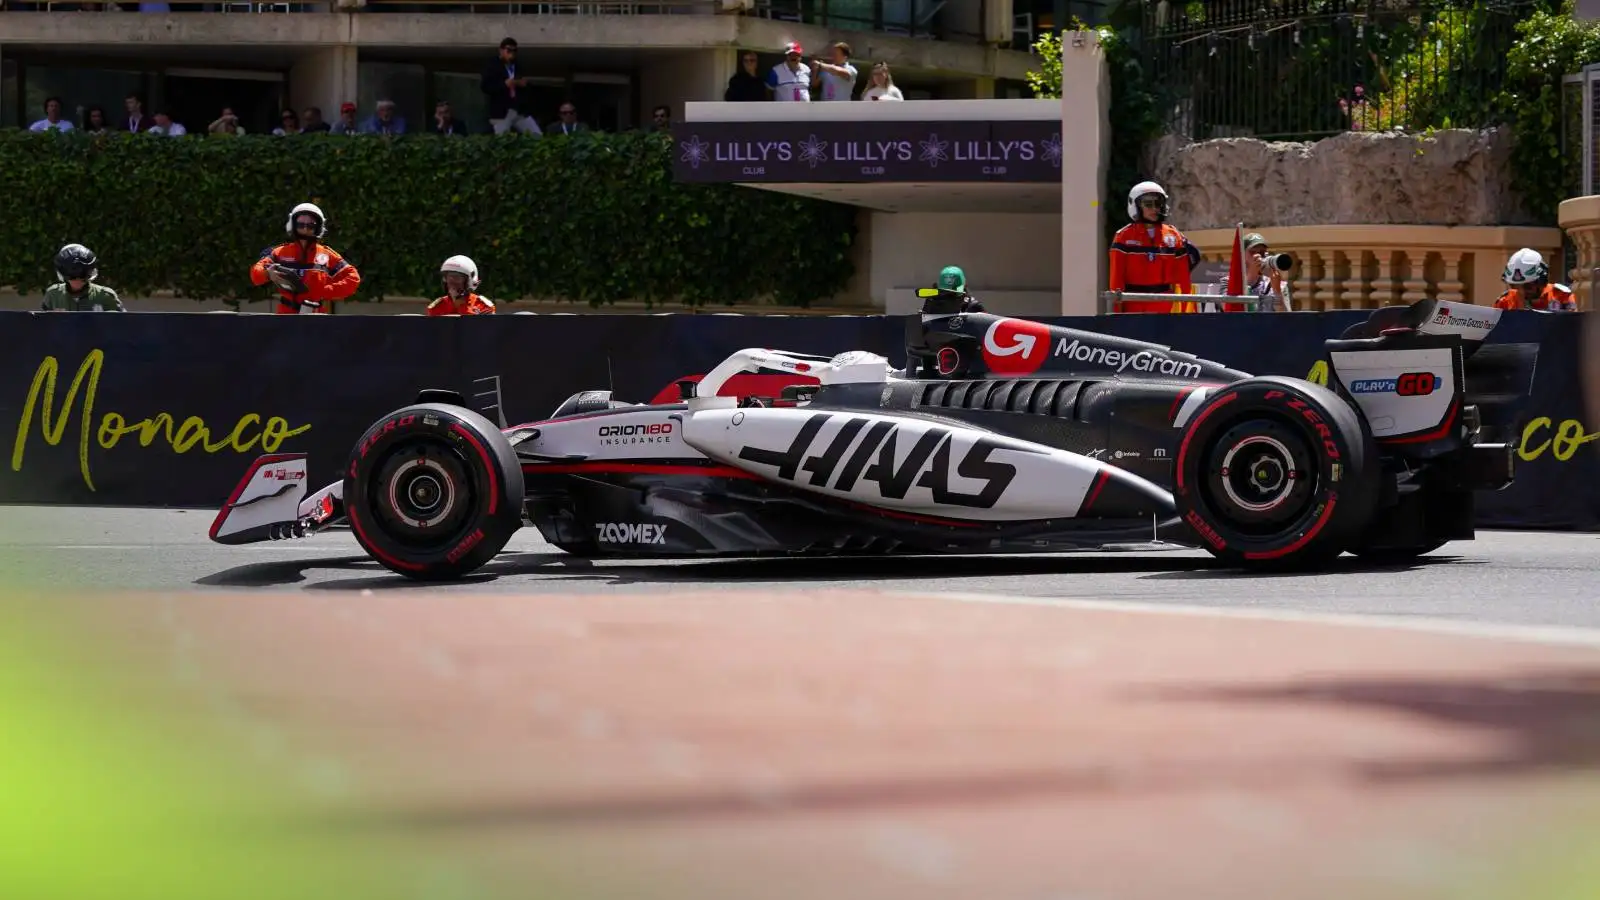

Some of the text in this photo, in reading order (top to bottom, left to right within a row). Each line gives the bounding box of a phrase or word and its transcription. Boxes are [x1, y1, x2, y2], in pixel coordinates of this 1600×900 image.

[715, 141, 793, 161] LILLY'S
[833, 141, 912, 161] LILLY'S
[954, 140, 1034, 161] LILLY'S
[1054, 337, 1202, 379] MoneyGram
[1399, 374, 1433, 395] GO
[12, 349, 311, 492] Monaco
[600, 436, 671, 446] INSURANCE
[738, 414, 1040, 508] HAAS
[595, 523, 668, 545] ZOOMEX
